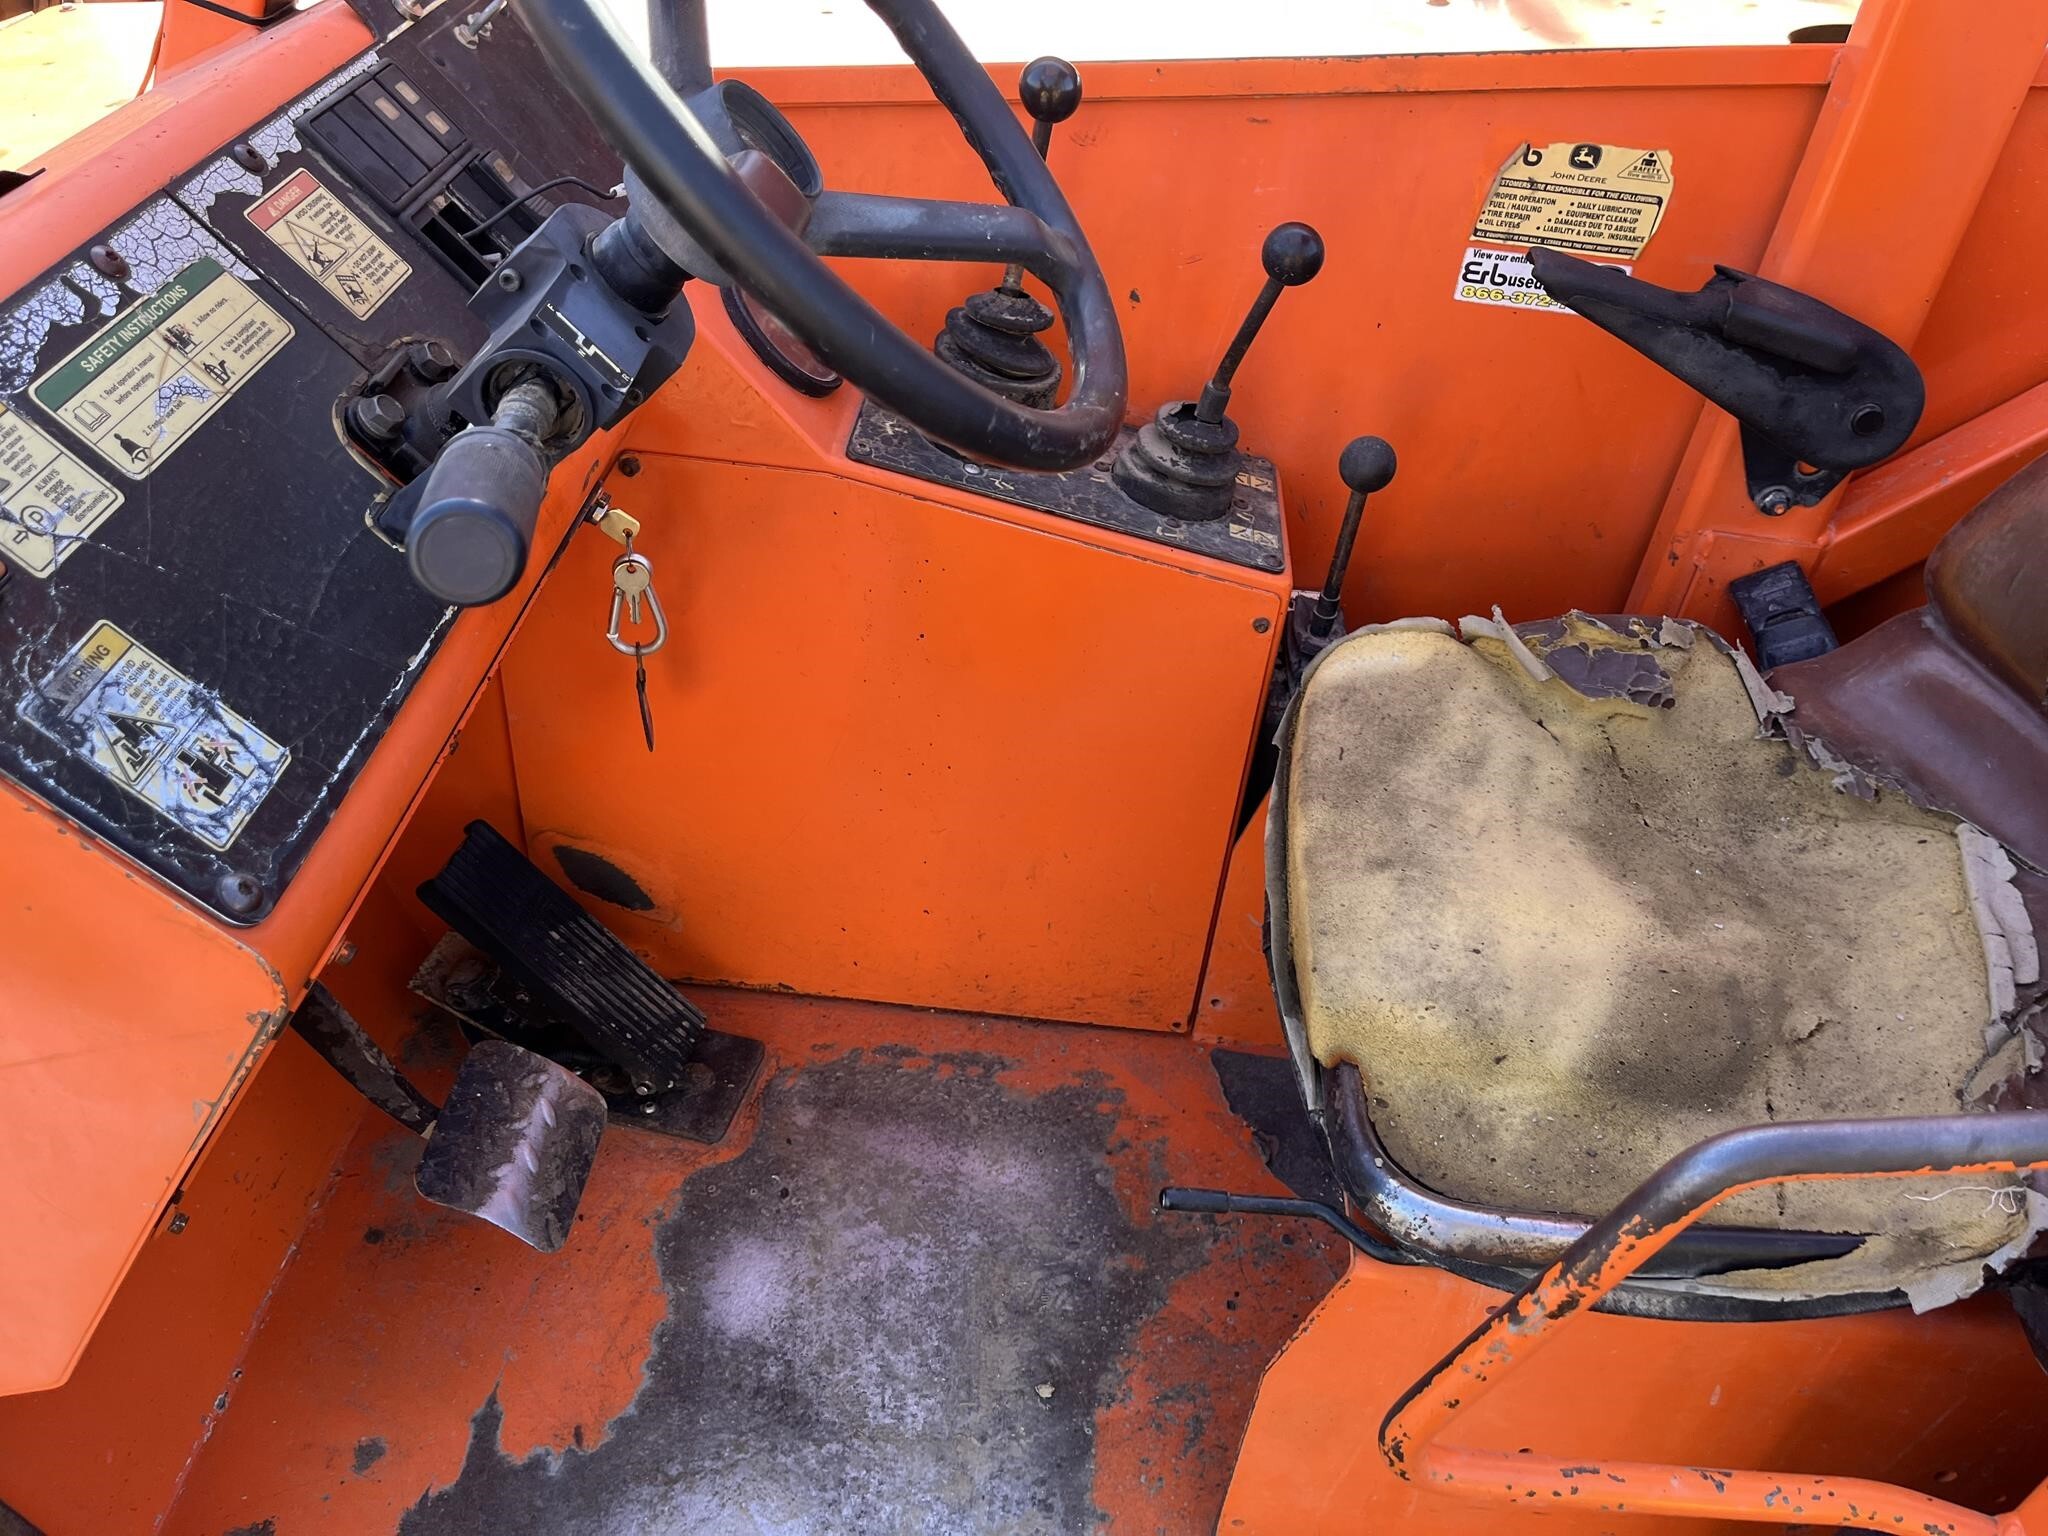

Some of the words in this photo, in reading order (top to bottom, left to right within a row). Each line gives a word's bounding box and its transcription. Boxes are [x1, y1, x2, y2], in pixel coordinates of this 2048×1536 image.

[1550, 170, 1576, 180] JOHN
[1576, 173, 1608, 184] DEERE
[1632, 165, 1661, 174] SAFETY
[1499, 178, 1532, 189] STOMERS
[1545, 183, 1591, 196] RESPONSIBLE
[1590, 189, 1605, 197] FOR
[1605, 191, 1619, 199] THE
[274, 185, 303, 210] DANGER
[1517, 193, 1557, 206] OPERATION
[1488, 200, 1507, 208] FUEL
[1510, 202, 1543, 213] HAULING
[1575, 201, 1596, 210] DAILY
[1596, 203, 1643, 216] LUBRICATION
[1485, 209, 1504, 217] TIRE
[1503, 211, 1531, 221] REPAIR
[1565, 209, 1604, 221] EQUIPMENT
[1605, 214, 1639, 225] CLEAN-UP
[1494, 219, 1521, 229] LEVELS
[1553, 216, 1588, 228] DAMAGES
[1587, 221, 1602, 229] DUE
[1613, 224, 1637, 233] ABUSE
[1542, 224, 1575, 235] LIABILITY
[1582, 229, 1606, 238] EQUIP.
[1607, 231, 1645, 243] INSURANCE
[1471, 248, 1493, 259] View
[1493, 253, 1509, 261] our
[1509, 253, 1530, 264] enti
[1460, 285, 1567, 309] 866-372-
[78, 335, 125, 373] SAFETY
[116, 282, 189, 343] INSTRUCTIONS
[102, 382, 120, 396] Read
[113, 388, 133, 405] before
[32, 467, 60, 491] ALWAYS
[42, 478, 67, 499] engage
[55, 642, 112, 698] WARNING
